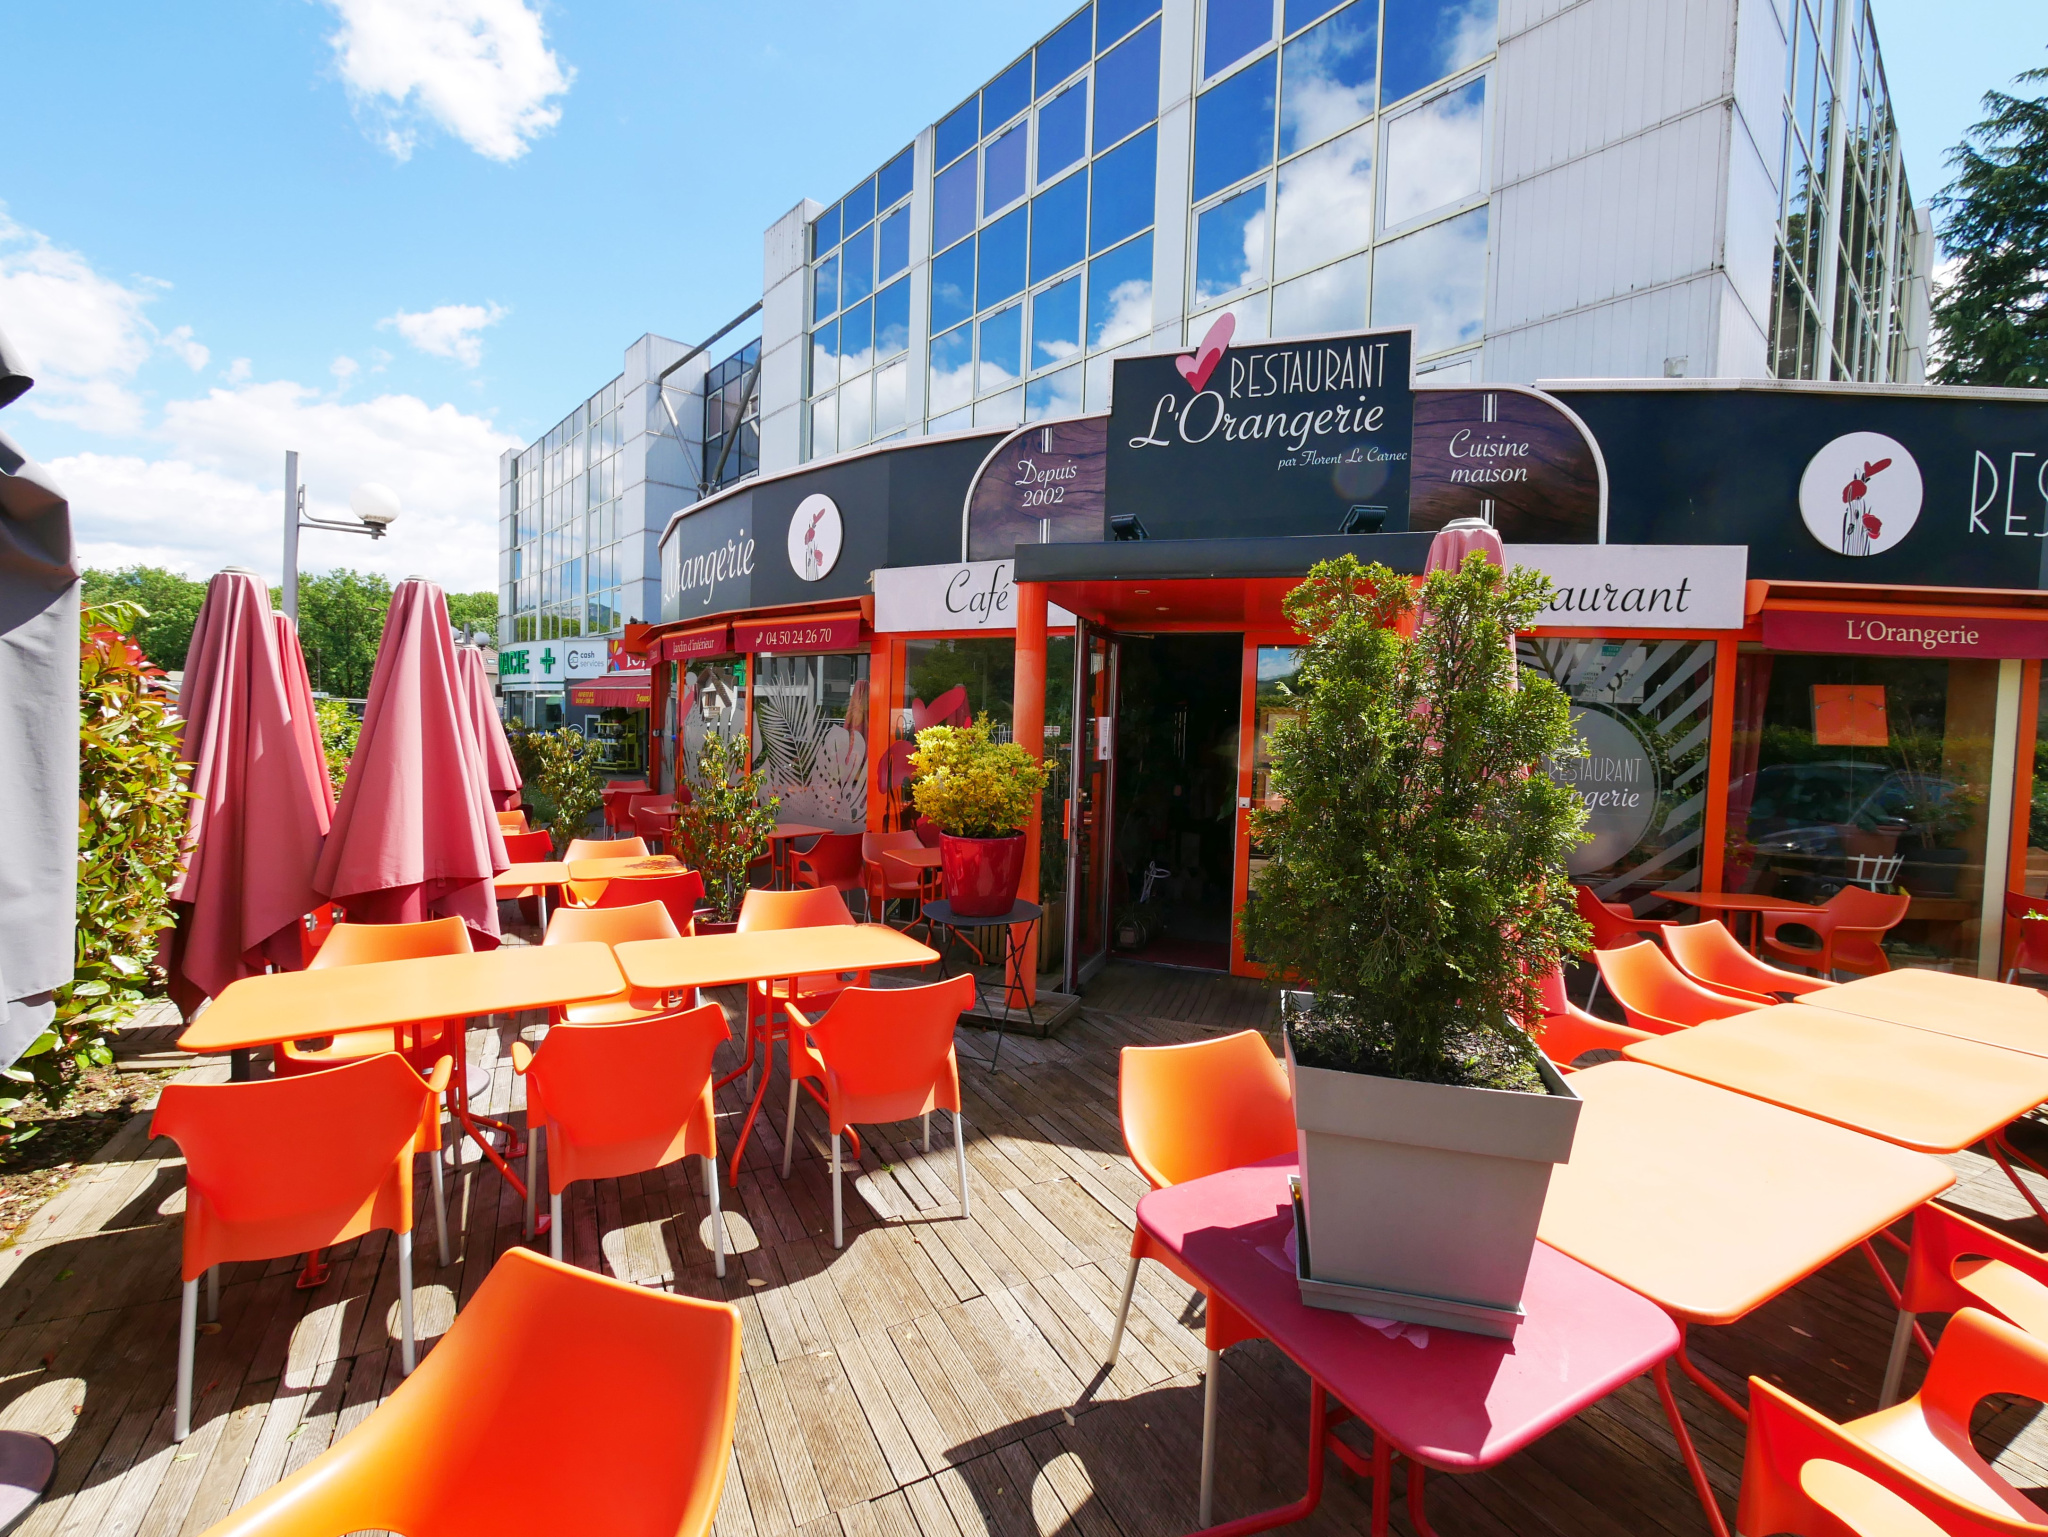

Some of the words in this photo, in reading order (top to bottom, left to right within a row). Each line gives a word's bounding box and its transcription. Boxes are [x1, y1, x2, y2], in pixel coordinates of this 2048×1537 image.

[1229, 343, 1389, 400] RESTAURANT
[1129, 391, 1384, 452] L'Orangerie
[1448, 428, 1530, 459] Cuisine
[1277, 457, 1297, 471] par
[1299, 449, 1342, 467] Florent
[1345, 447, 1364, 463] Le
[1366, 446, 1408, 462] Carnec
[1014, 458, 1078, 492] Depuis
[1449, 461, 1529, 484] maison
[1020, 485, 1066, 507] 2002
[944, 564, 1009, 624] Café
[765, 631, 777, 645] 04
[779, 631, 791, 645] 50
[792, 630, 803, 644] 24
[805, 629, 817, 643] 26
[819, 628, 832, 643] 70
[1846, 620, 1980, 650] L'Orangerie
[580, 650, 595, 659] cash
[672, 640, 688, 656] Jardin
[580, 659, 605, 668] services
